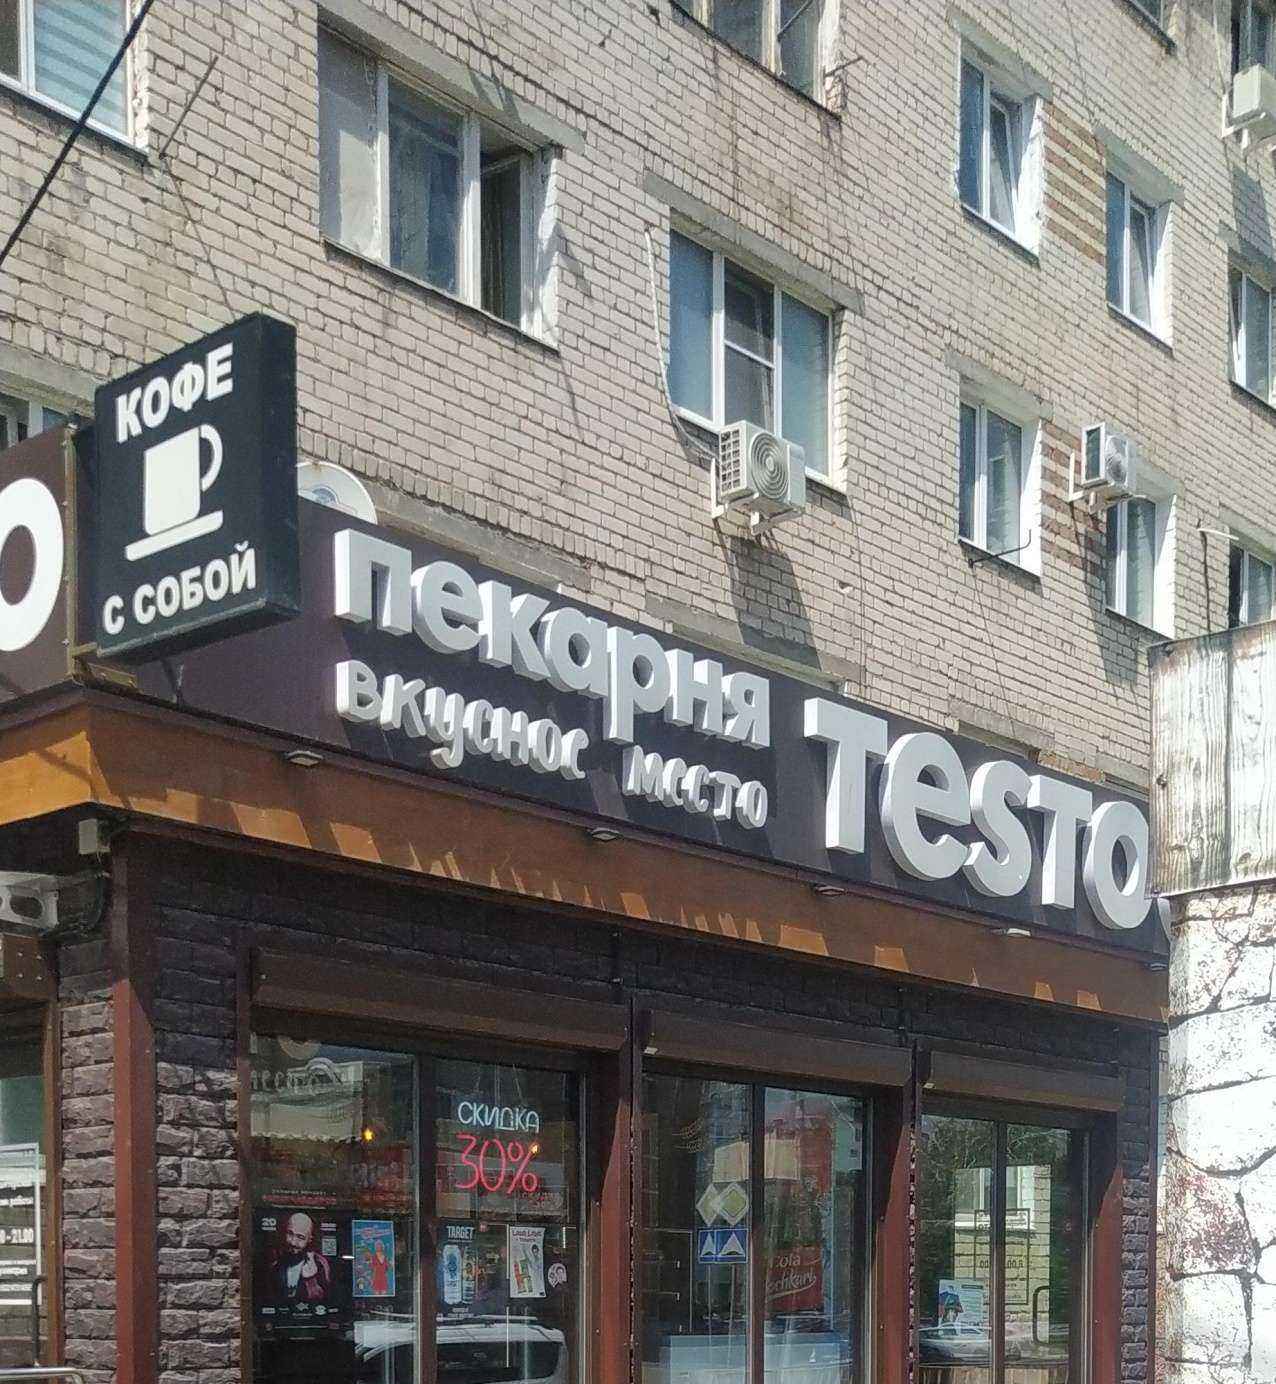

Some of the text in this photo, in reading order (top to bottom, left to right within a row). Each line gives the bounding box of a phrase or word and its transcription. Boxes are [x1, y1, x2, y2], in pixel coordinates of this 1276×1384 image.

[115, 342, 234, 444] КОФЕ
[132, 540, 257, 625] СОБОЙ
[334, 528, 771, 750] пекарня
[457, 1101, 540, 1133] СКИДКА
[455, 1133, 539, 1196] 30%
[447, 1225, 475, 1239] TARGET
